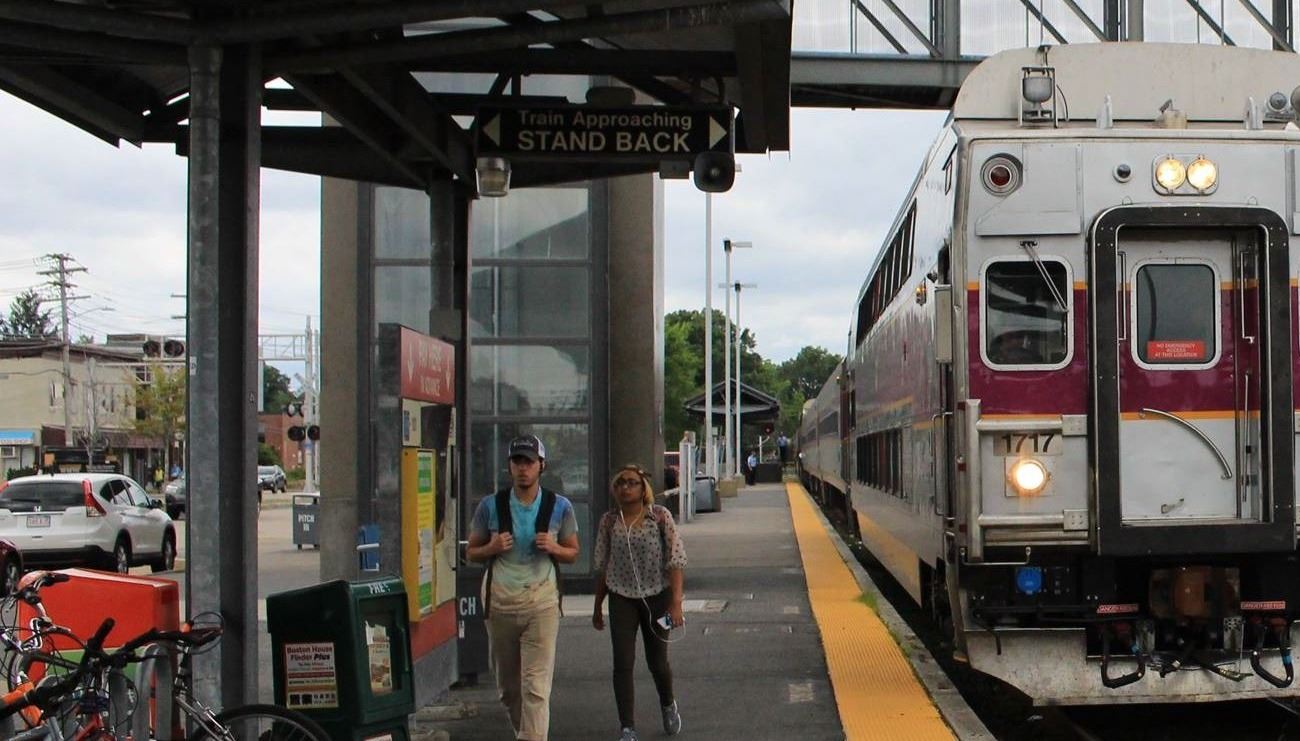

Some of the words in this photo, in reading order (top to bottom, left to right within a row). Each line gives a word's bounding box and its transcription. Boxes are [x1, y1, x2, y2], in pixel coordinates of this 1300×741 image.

[518, 110, 564, 126] Train
[572, 111, 692, 130] Approaching
[517, 130, 606, 151] STAND
[615, 131, 691, 152] BACK
[1002, 433, 1055, 453] 1717
[298, 514, 315, 522] PITCH
[287, 646, 311, 654] Boston
[312, 645, 333, 653] House
[314, 653, 330, 661] Plus
